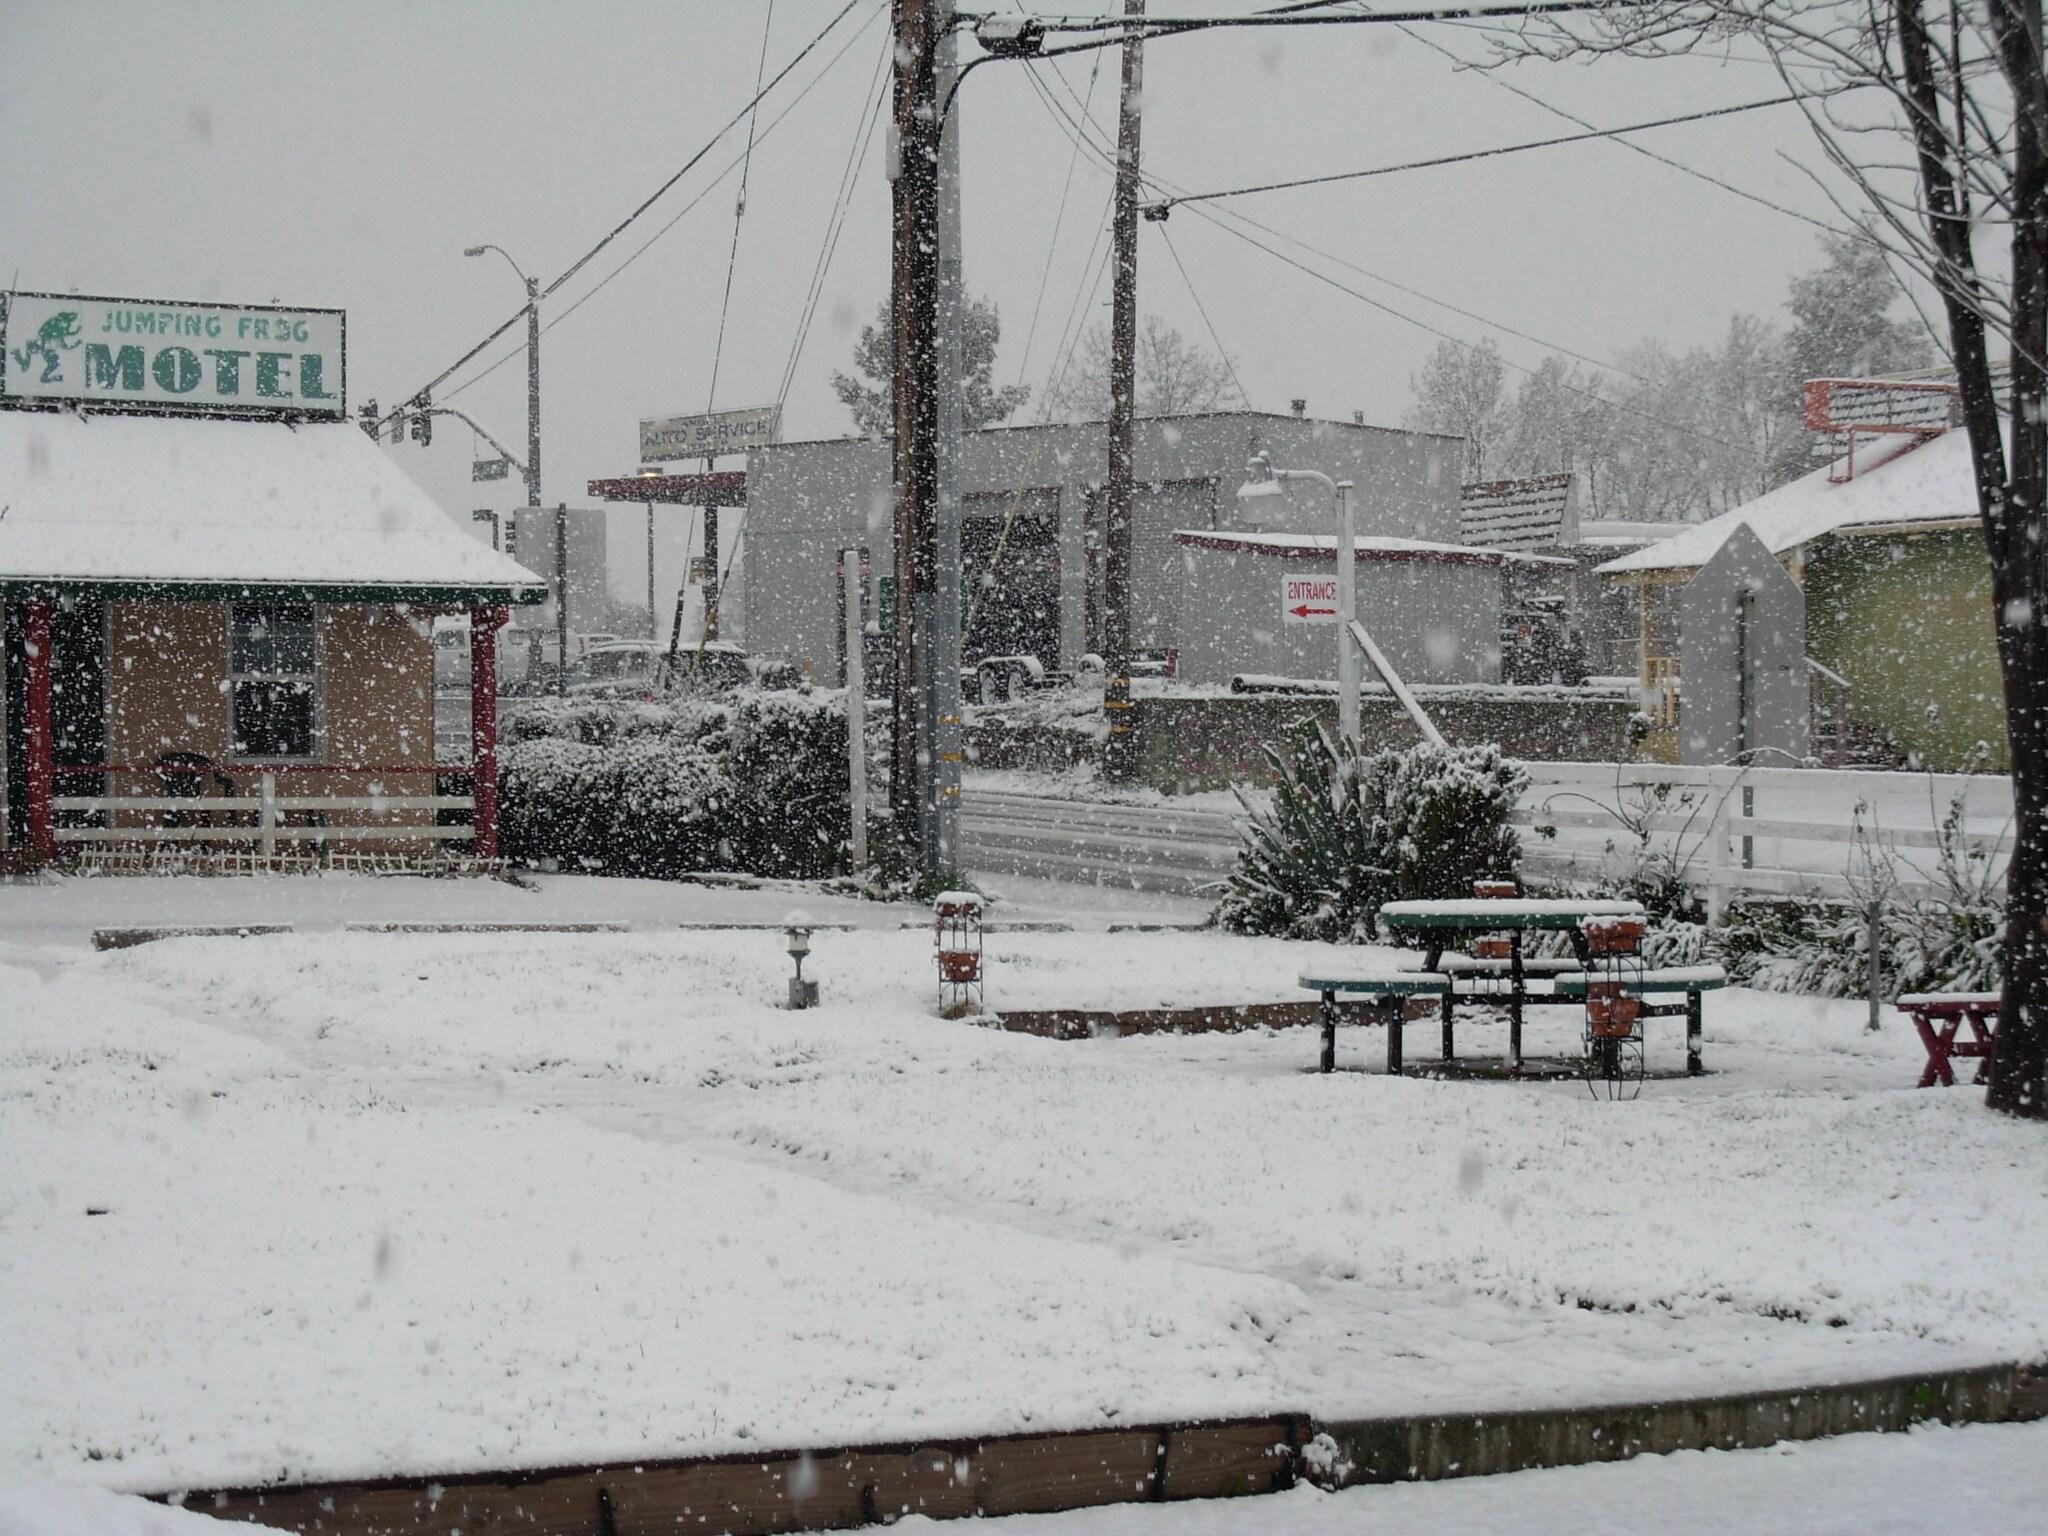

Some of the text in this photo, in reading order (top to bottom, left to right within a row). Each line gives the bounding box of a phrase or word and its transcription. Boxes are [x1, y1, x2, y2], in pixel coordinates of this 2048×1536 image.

[102, 311, 221, 338] JUMPING
[85, 343, 339, 399] MOTEL
[645, 430, 687, 446] AUTO
[695, 420, 767, 441] SERVICE
[1288, 582, 1336, 600] ENTRANCE
